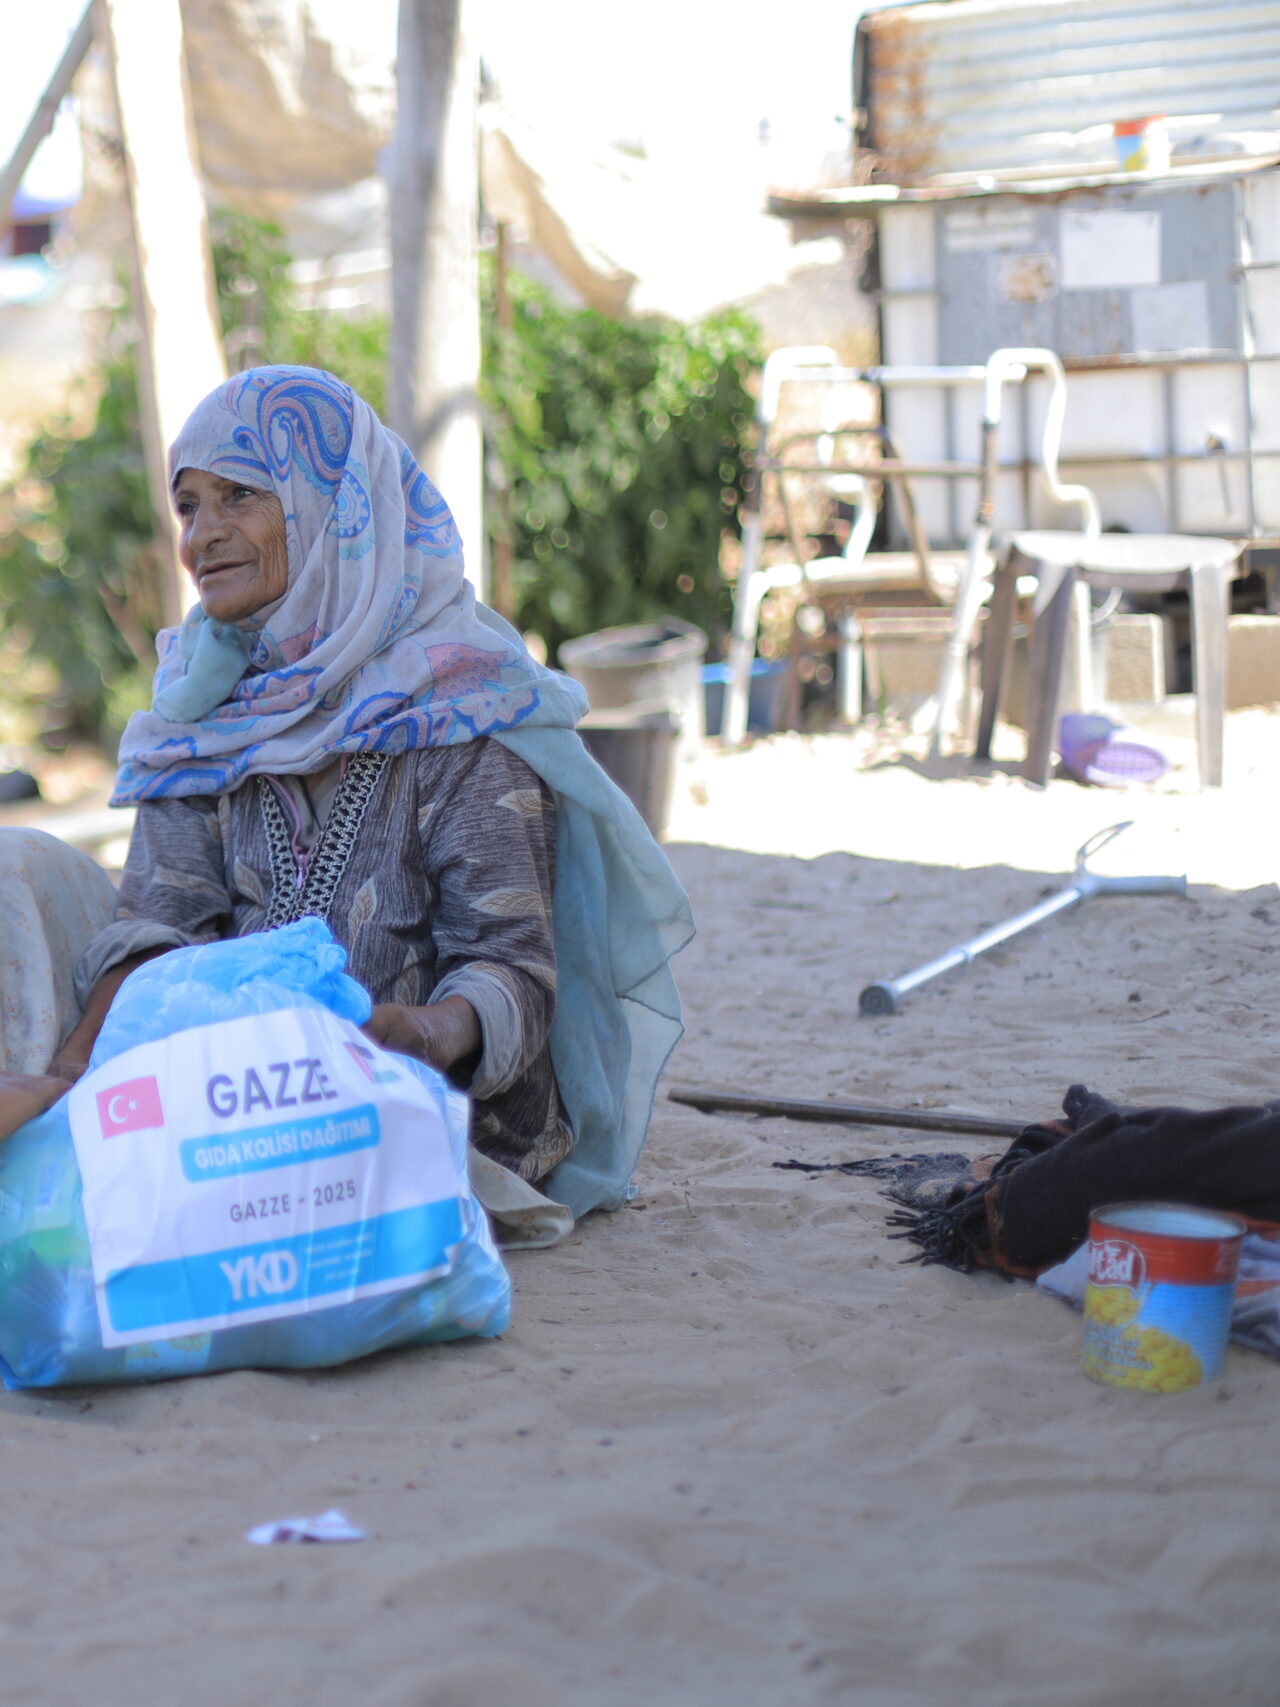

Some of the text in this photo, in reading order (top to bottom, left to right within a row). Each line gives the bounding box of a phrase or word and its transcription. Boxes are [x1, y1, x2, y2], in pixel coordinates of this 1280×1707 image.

[206, 1058, 338, 1118] GAZZE
[194, 1116, 372, 1170] GIDA KOLİSİ DAĞITIMI
[229, 1193, 291, 1223] GAZZE
[314, 1178, 357, 1207] 2025
[220, 1249, 298, 1301] YKD
